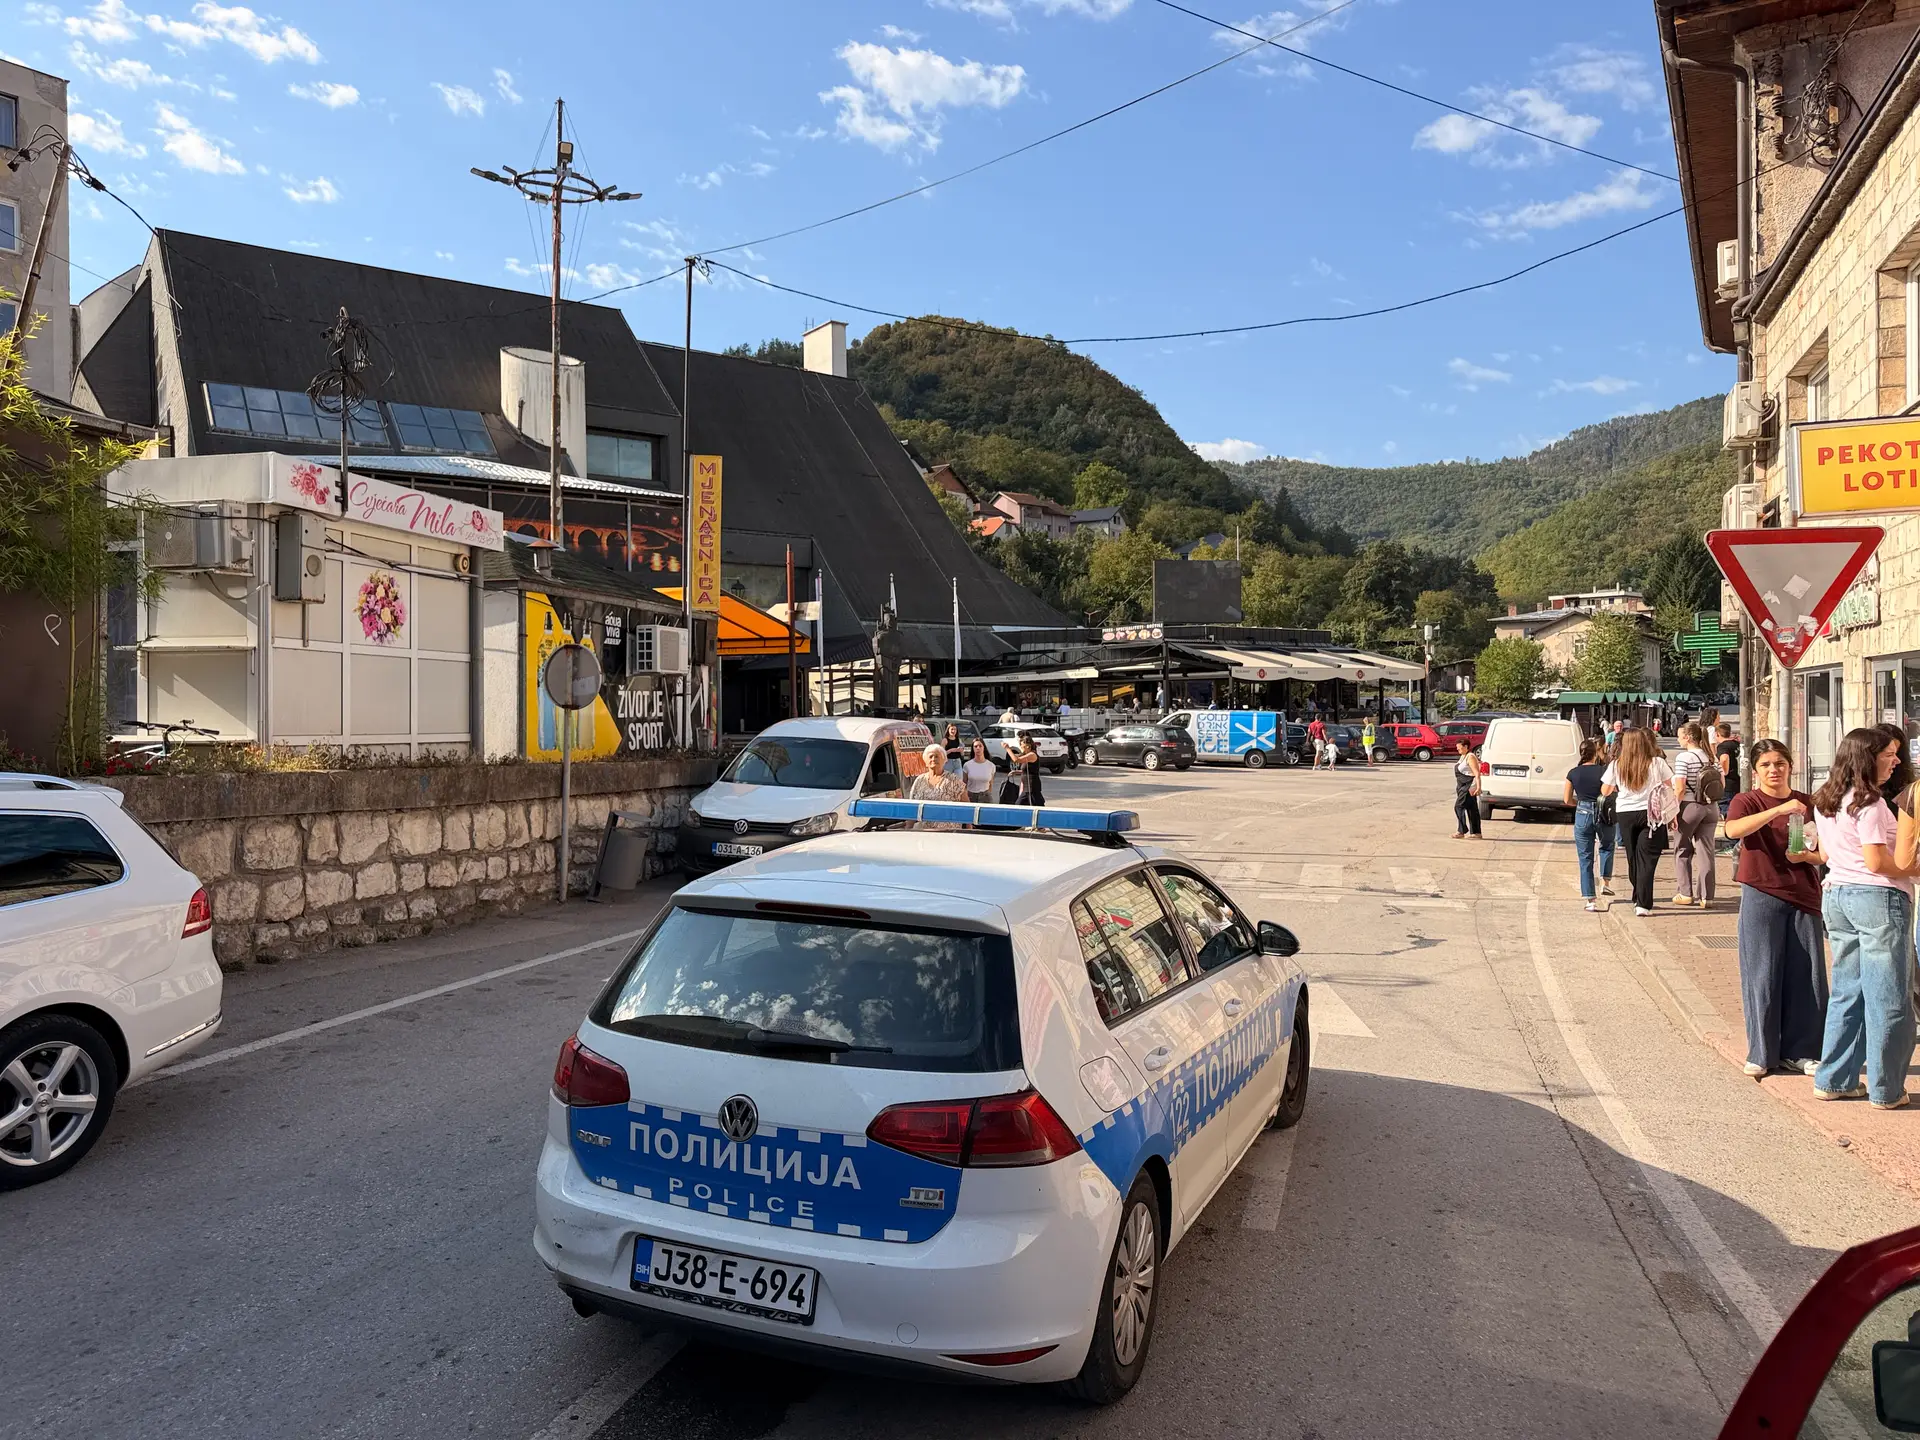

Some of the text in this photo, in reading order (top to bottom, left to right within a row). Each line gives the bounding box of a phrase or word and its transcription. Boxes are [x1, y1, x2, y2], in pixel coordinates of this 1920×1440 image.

[1818, 440, 1920, 466] PEKOT
[1843, 469, 1918, 493] LOTI
[397, 494, 457, 537] Mila
[617, 685, 664, 718] ŽIVOT JE
[1197, 713, 1228, 721] COLD
[1197, 722, 1228, 730] DRINK
[628, 721, 664, 751] SPORT
[717, 844, 761, 856] 031-A-136
[1195, 1011, 1272, 1113] ПОЛИЦИЈА
[1170, 1091, 1189, 1140] 122
[629, 1121, 861, 1190] ПОЛИЦИЈА
[669, 1177, 814, 1218] POLICE
[911, 1188, 944, 1201] TDI
[636, 1263, 650, 1274] BIH
[653, 1248, 807, 1308] J38-E-694
